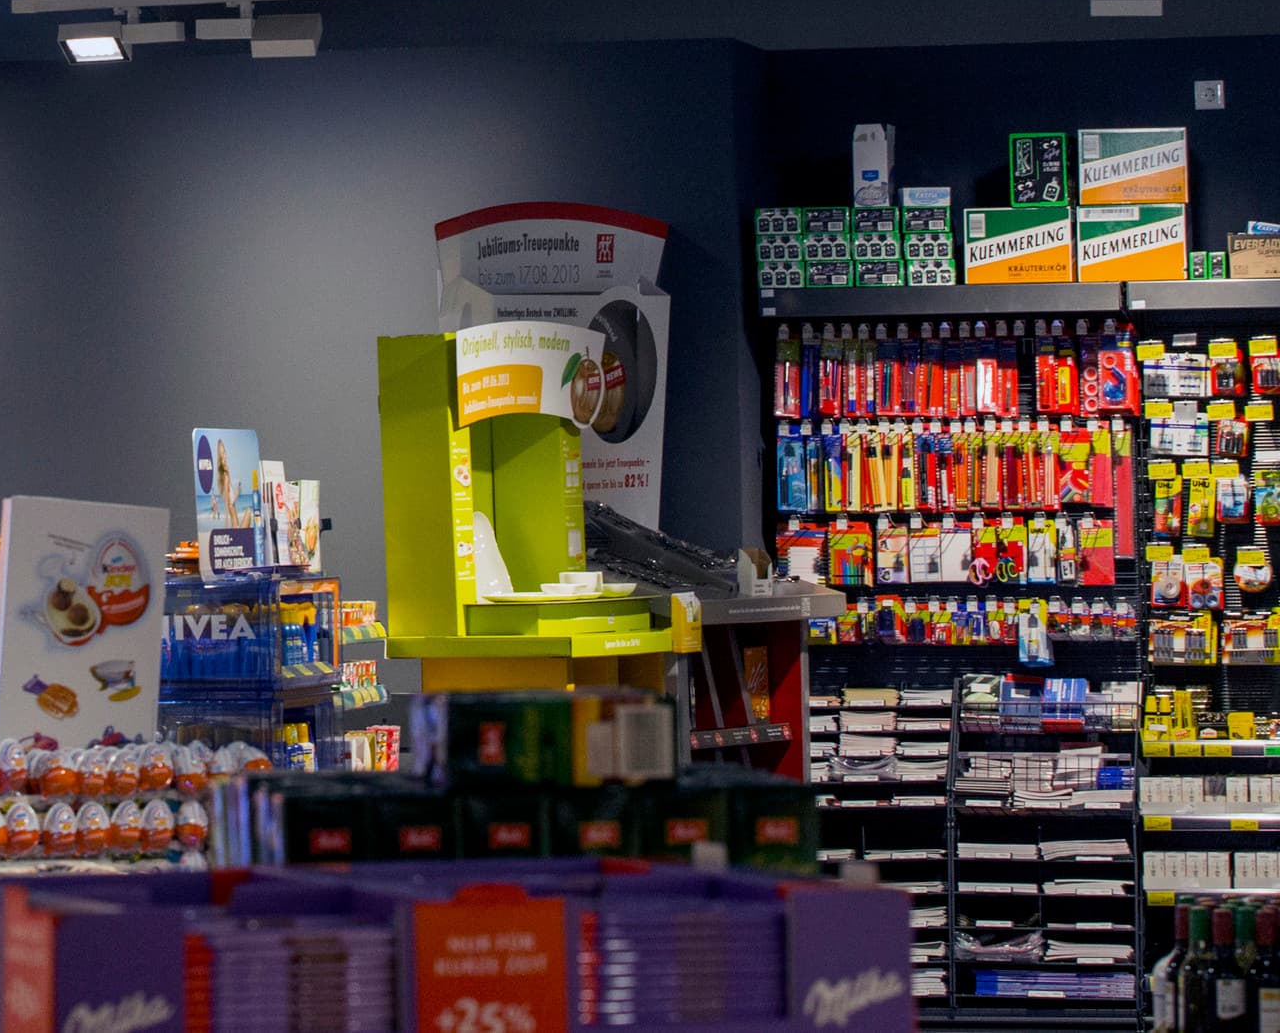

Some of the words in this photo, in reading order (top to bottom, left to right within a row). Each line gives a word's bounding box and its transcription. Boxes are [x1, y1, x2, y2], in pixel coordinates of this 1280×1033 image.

[1083, 148, 1181, 186] KUEMMERLING
[478, 231, 580, 260] Jubiläums-Treuepunkte
[970, 226, 1066, 263] KUEMMERLING
[1082, 224, 1180, 261] KUEMMERLING
[538, 331, 571, 352] modern
